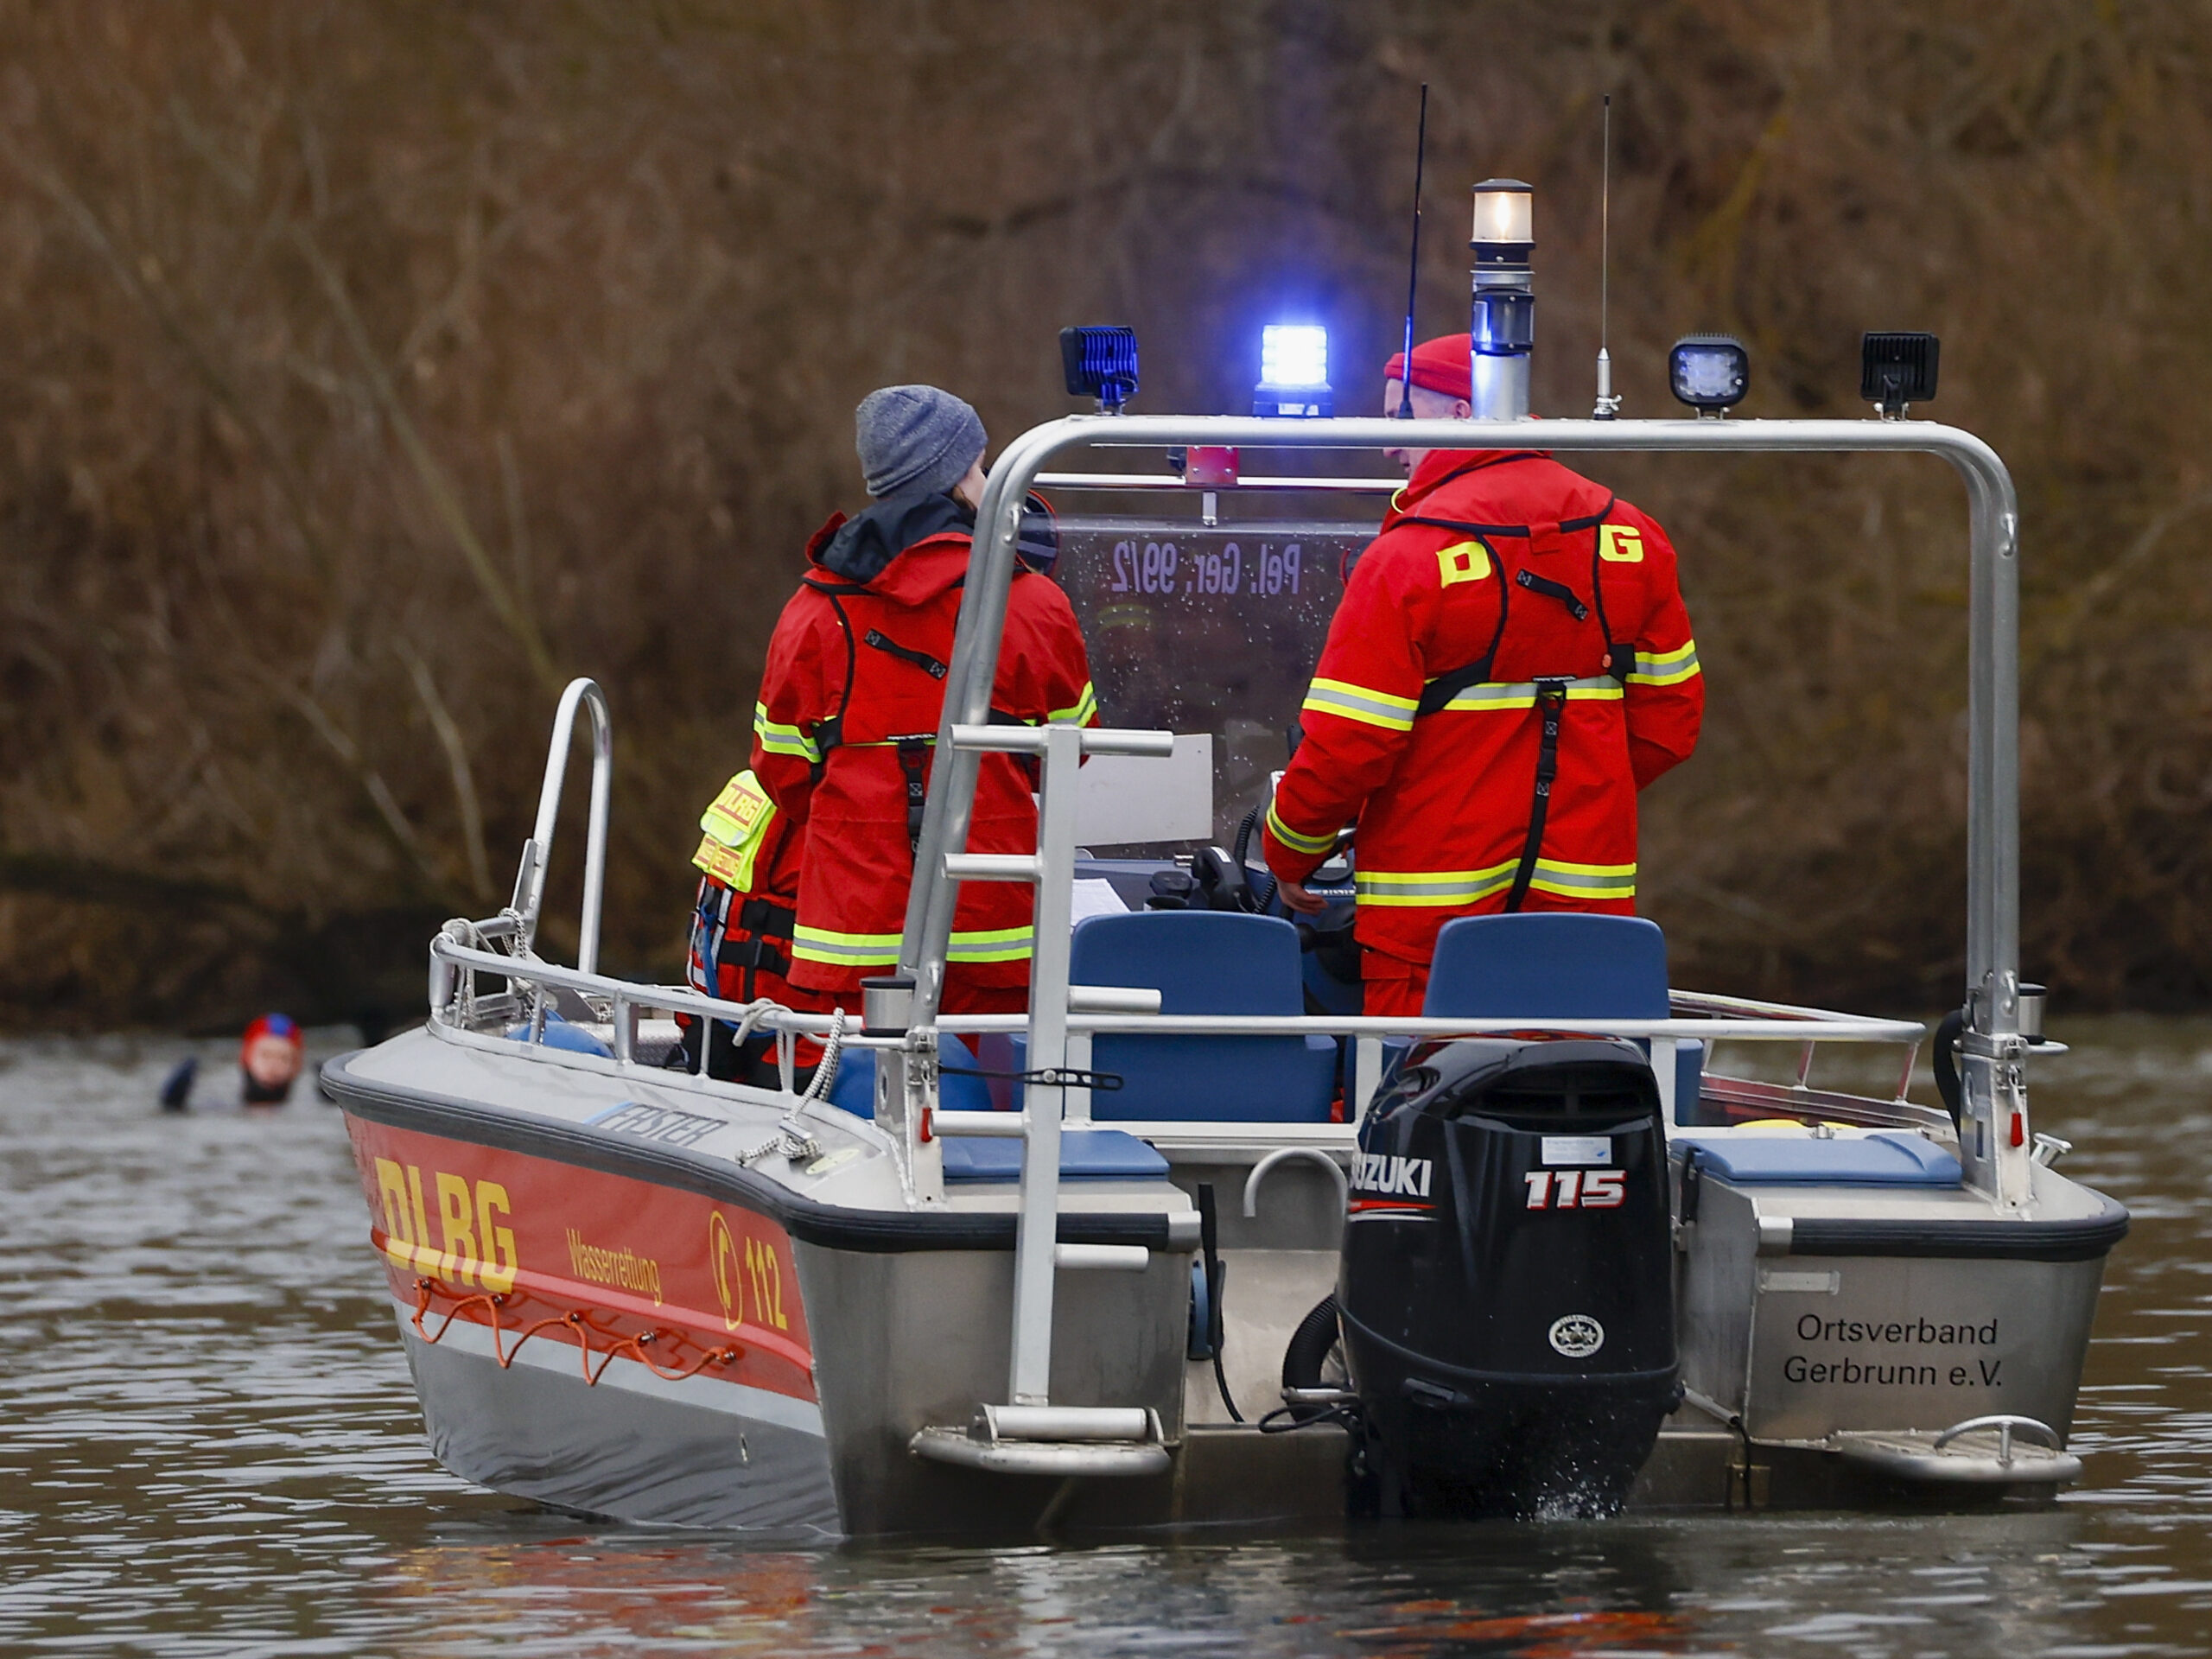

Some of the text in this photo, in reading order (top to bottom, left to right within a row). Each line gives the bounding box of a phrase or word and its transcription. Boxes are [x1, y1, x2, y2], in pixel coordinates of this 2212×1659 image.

[1524, 1169, 1627, 1210] 115
[374, 1156, 517, 1294] DLRG
[566, 1228, 662, 1307] Wasserrettung
[745, 1236, 788, 1331] 112
[1797, 1313, 1998, 1344] Ortsverband
[1784, 1355, 2002, 1387] Gerbrunn e.V.
